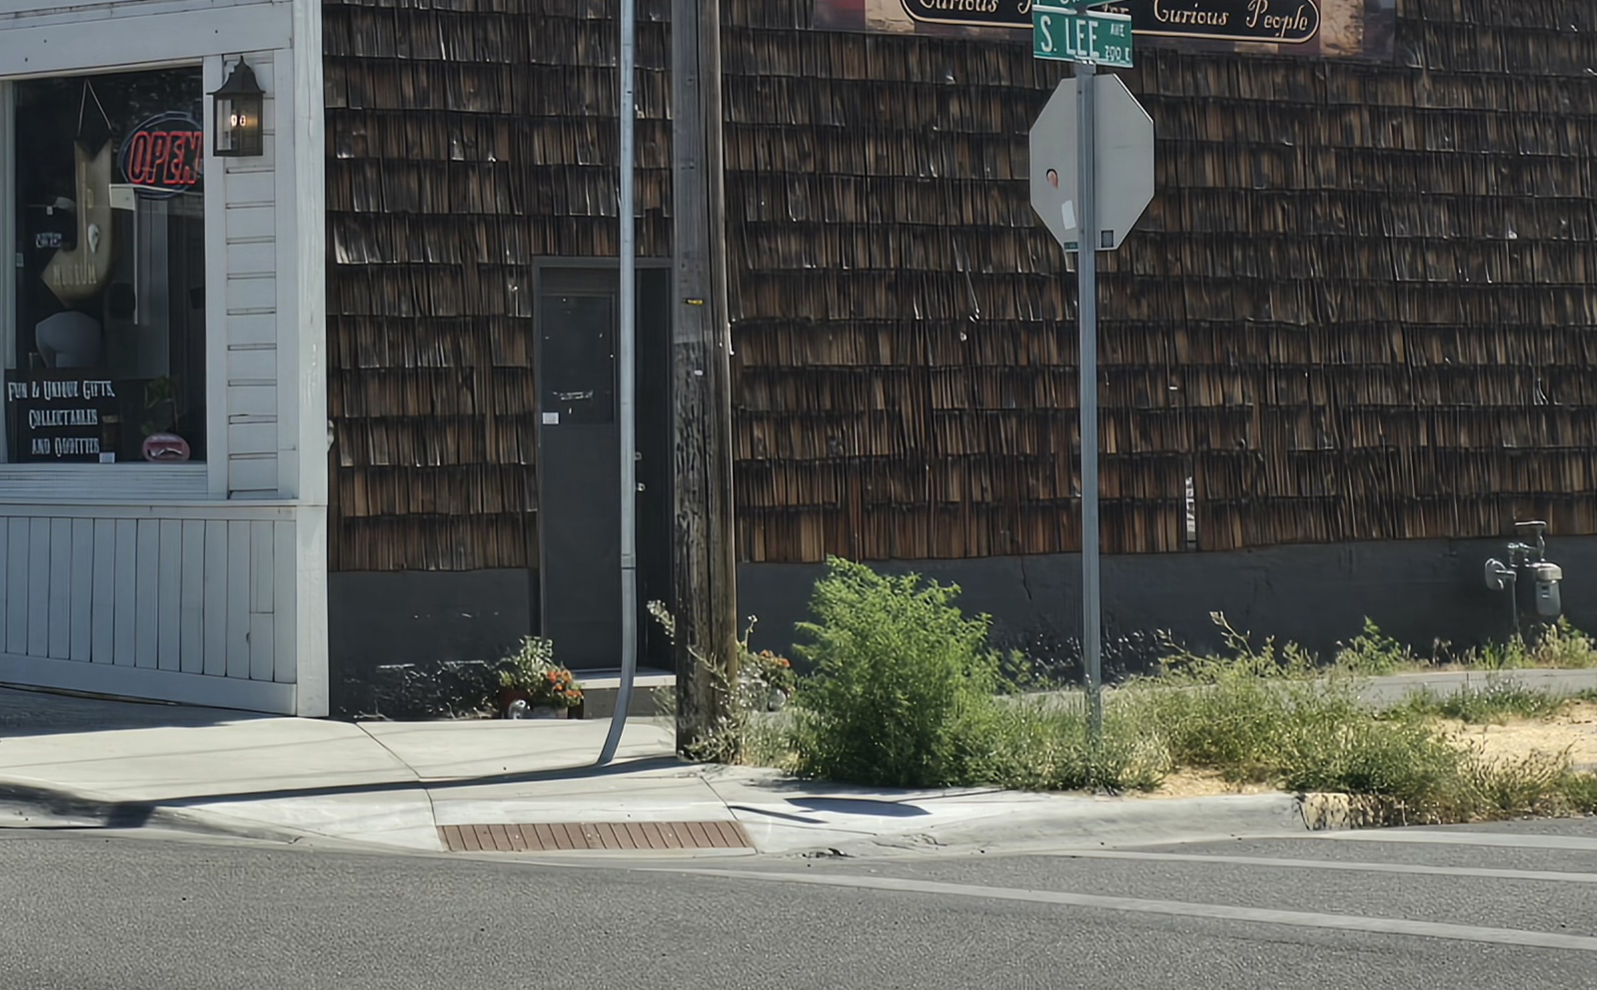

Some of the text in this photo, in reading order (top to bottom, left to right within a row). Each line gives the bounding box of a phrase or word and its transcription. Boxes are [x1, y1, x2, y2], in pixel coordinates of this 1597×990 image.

[1040, 15, 1057, 53] S.
[1064, 18, 1100, 59] LEE
[128, 131, 203, 185] OPEN
